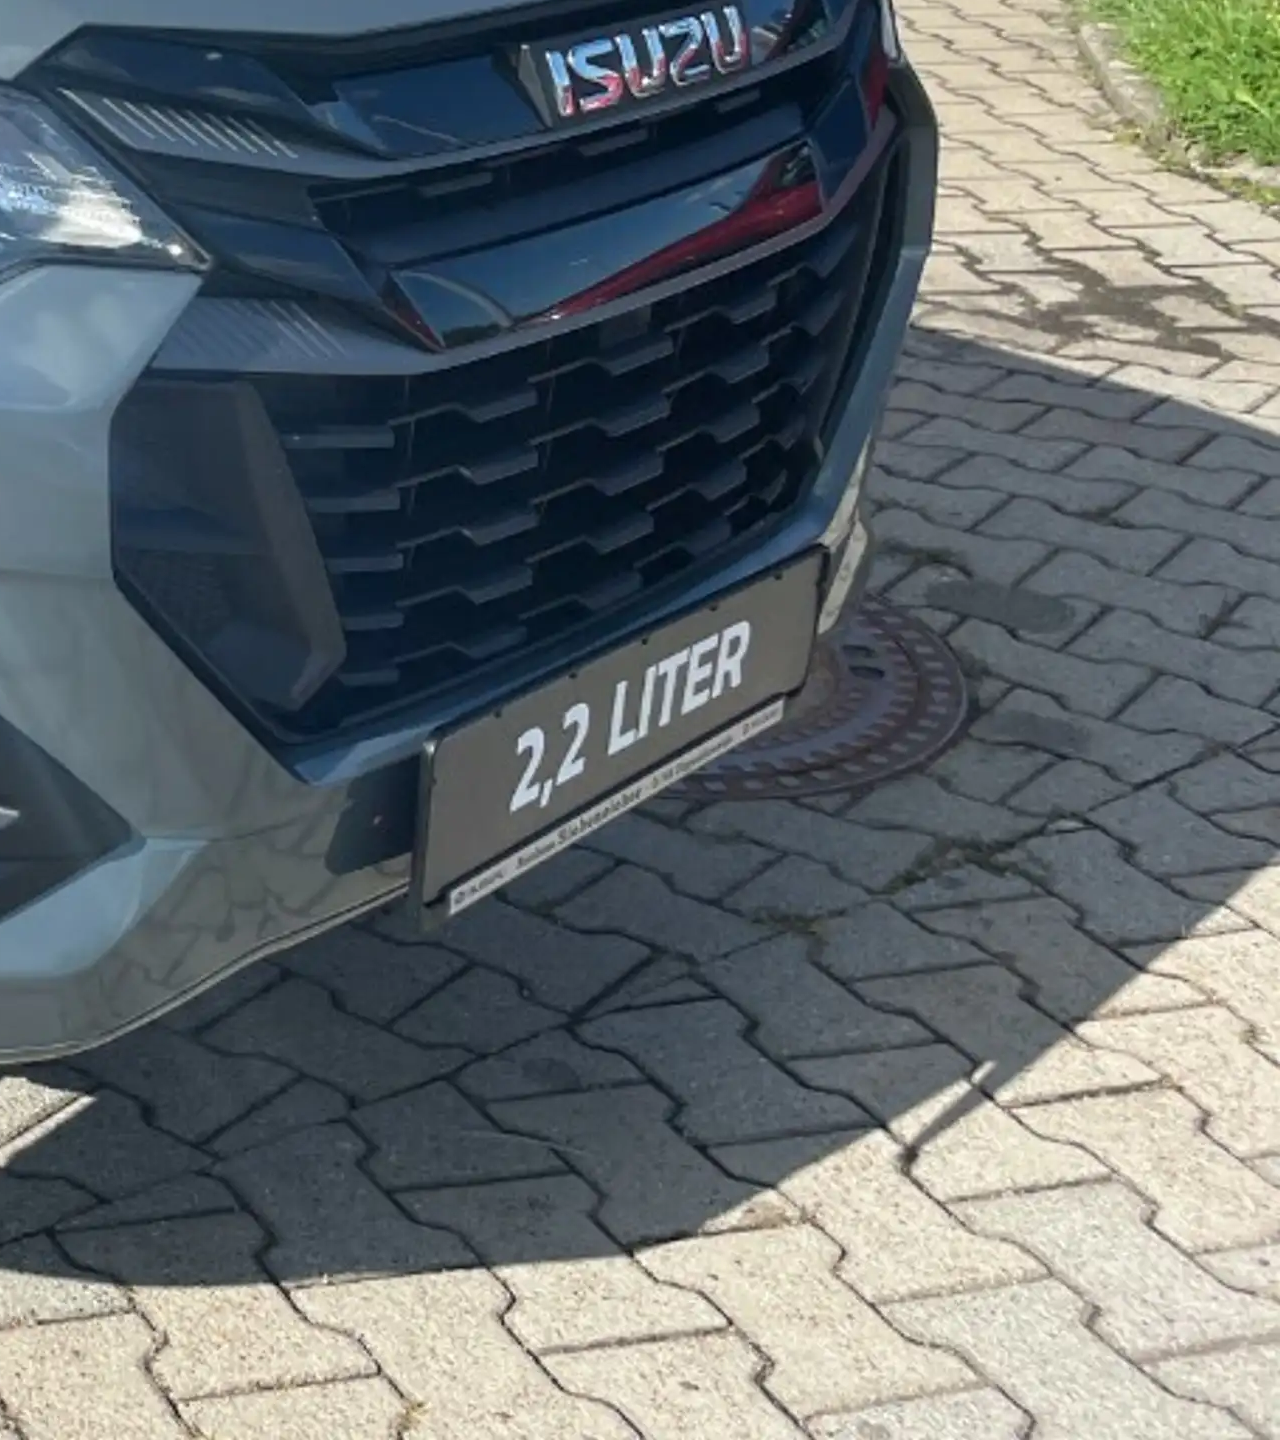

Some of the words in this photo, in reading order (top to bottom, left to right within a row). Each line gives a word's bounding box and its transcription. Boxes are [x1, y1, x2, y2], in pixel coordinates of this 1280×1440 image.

[545, 6, 748, 117] ISUZU
[510, 702, 589, 813] 2,2
[607, 620, 751, 756] LITER
